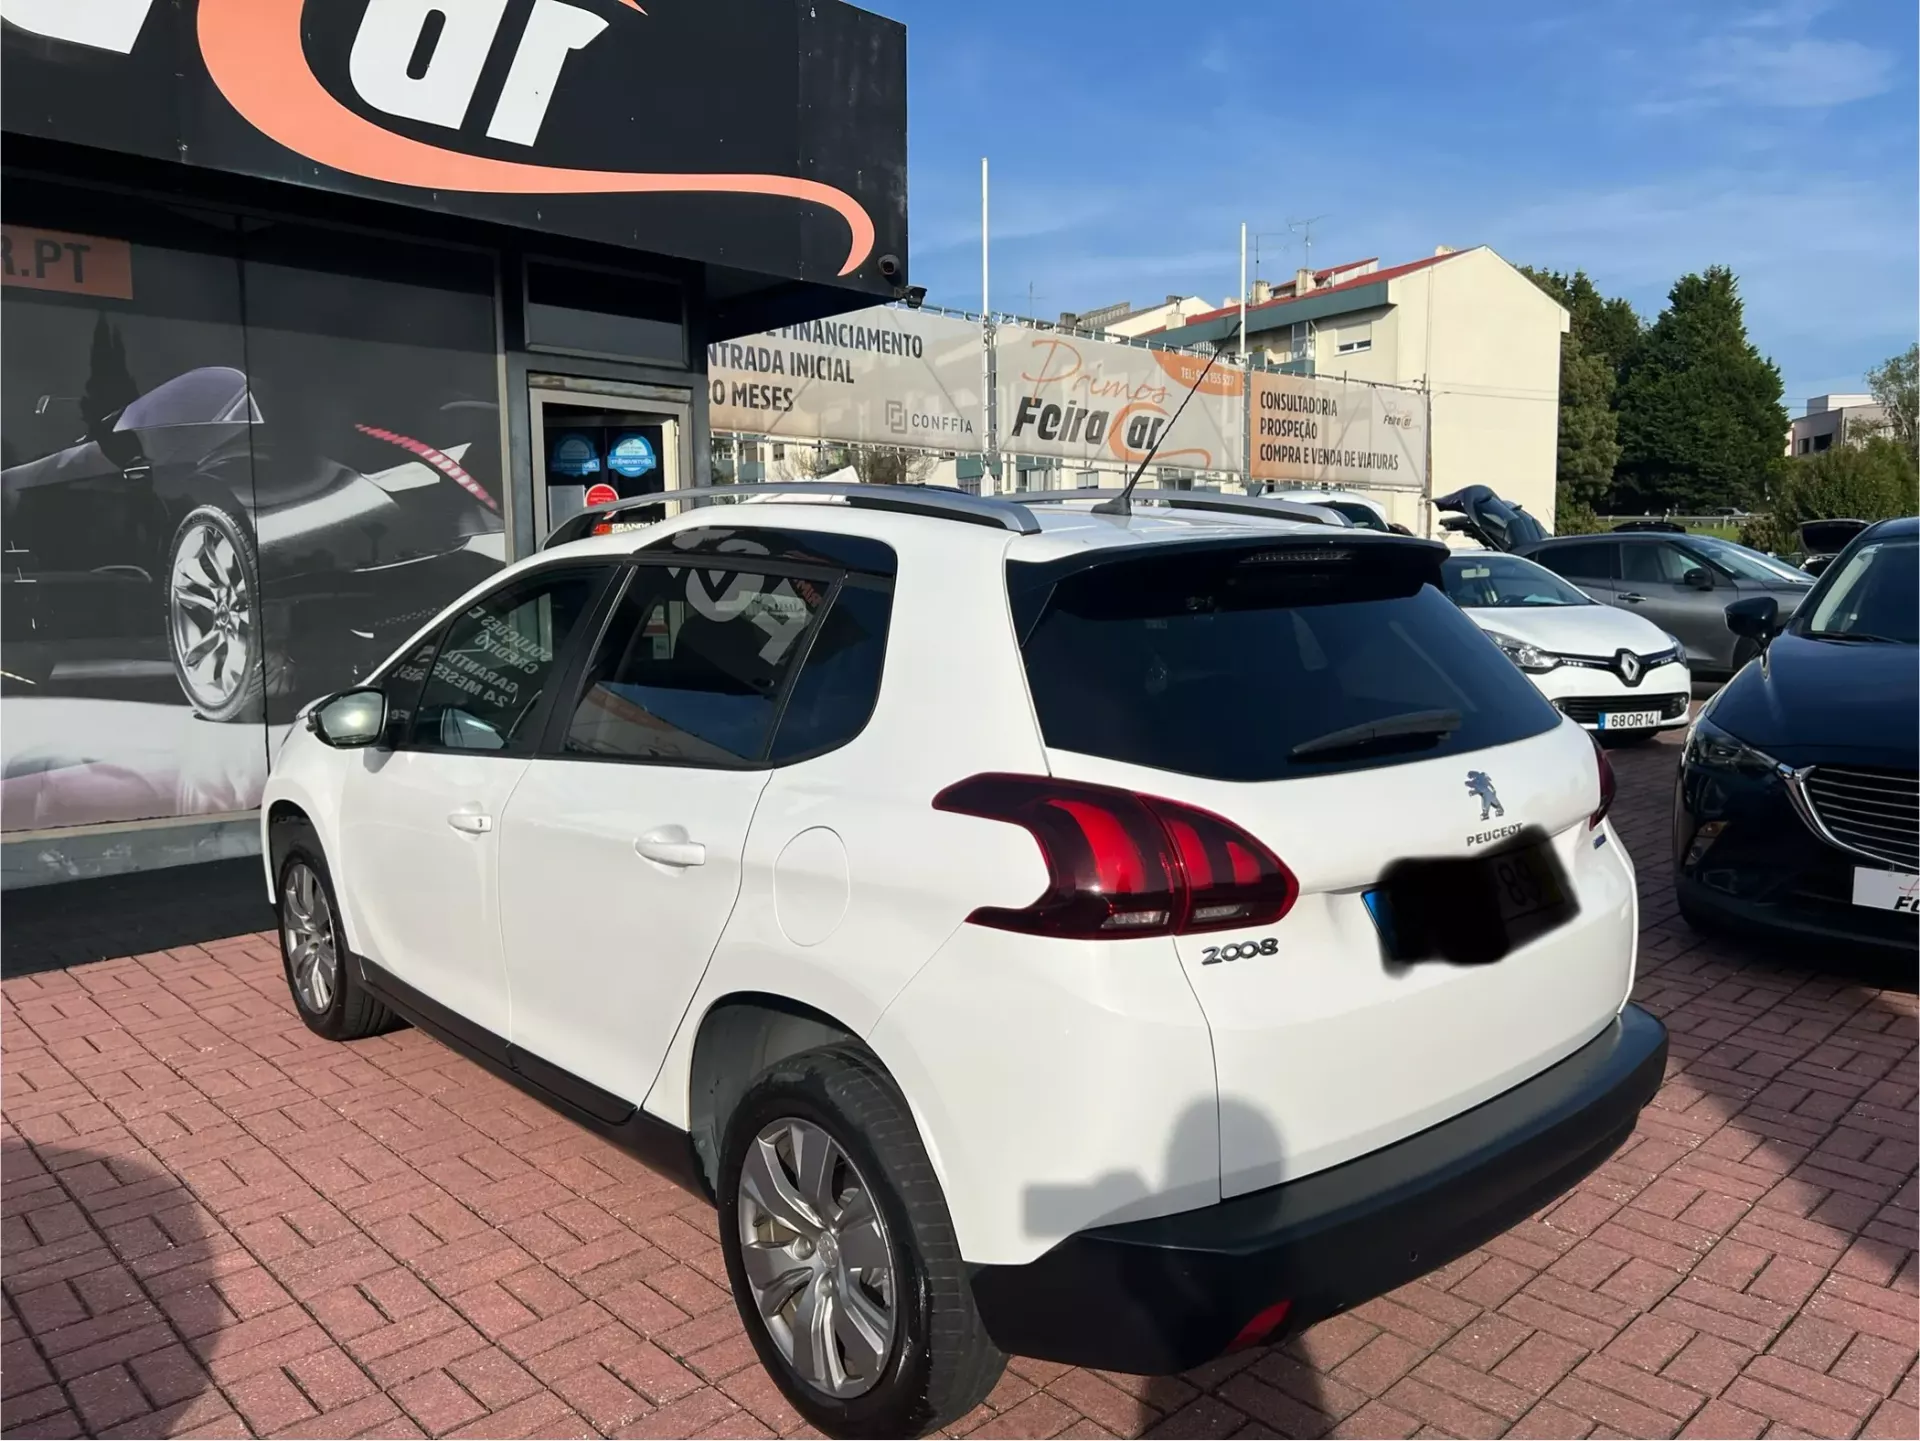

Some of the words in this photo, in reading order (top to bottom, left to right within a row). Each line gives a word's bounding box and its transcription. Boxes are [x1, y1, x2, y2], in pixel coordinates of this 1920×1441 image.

[791, 352, 854, 384] INICIAL
[1022, 338, 1172, 405] Primos
[732, 381, 793, 412] MESES
[1260, 391, 1337, 417] CONSULTADORIA
[911, 413, 973, 434] CONFFIA
[1260, 417, 1318, 442] PROSPEÇÃO
[1260, 443, 1301, 464] COMPRA
[1304, 447, 1309, 464] E
[1312, 448, 1342, 467] VENDA
[1344, 451, 1356, 468] DE
[1357, 451, 1399, 471] VIATURAS
[1466, 822, 1523, 847] PEUGEOT
[1201, 937, 1279, 966] 2008
